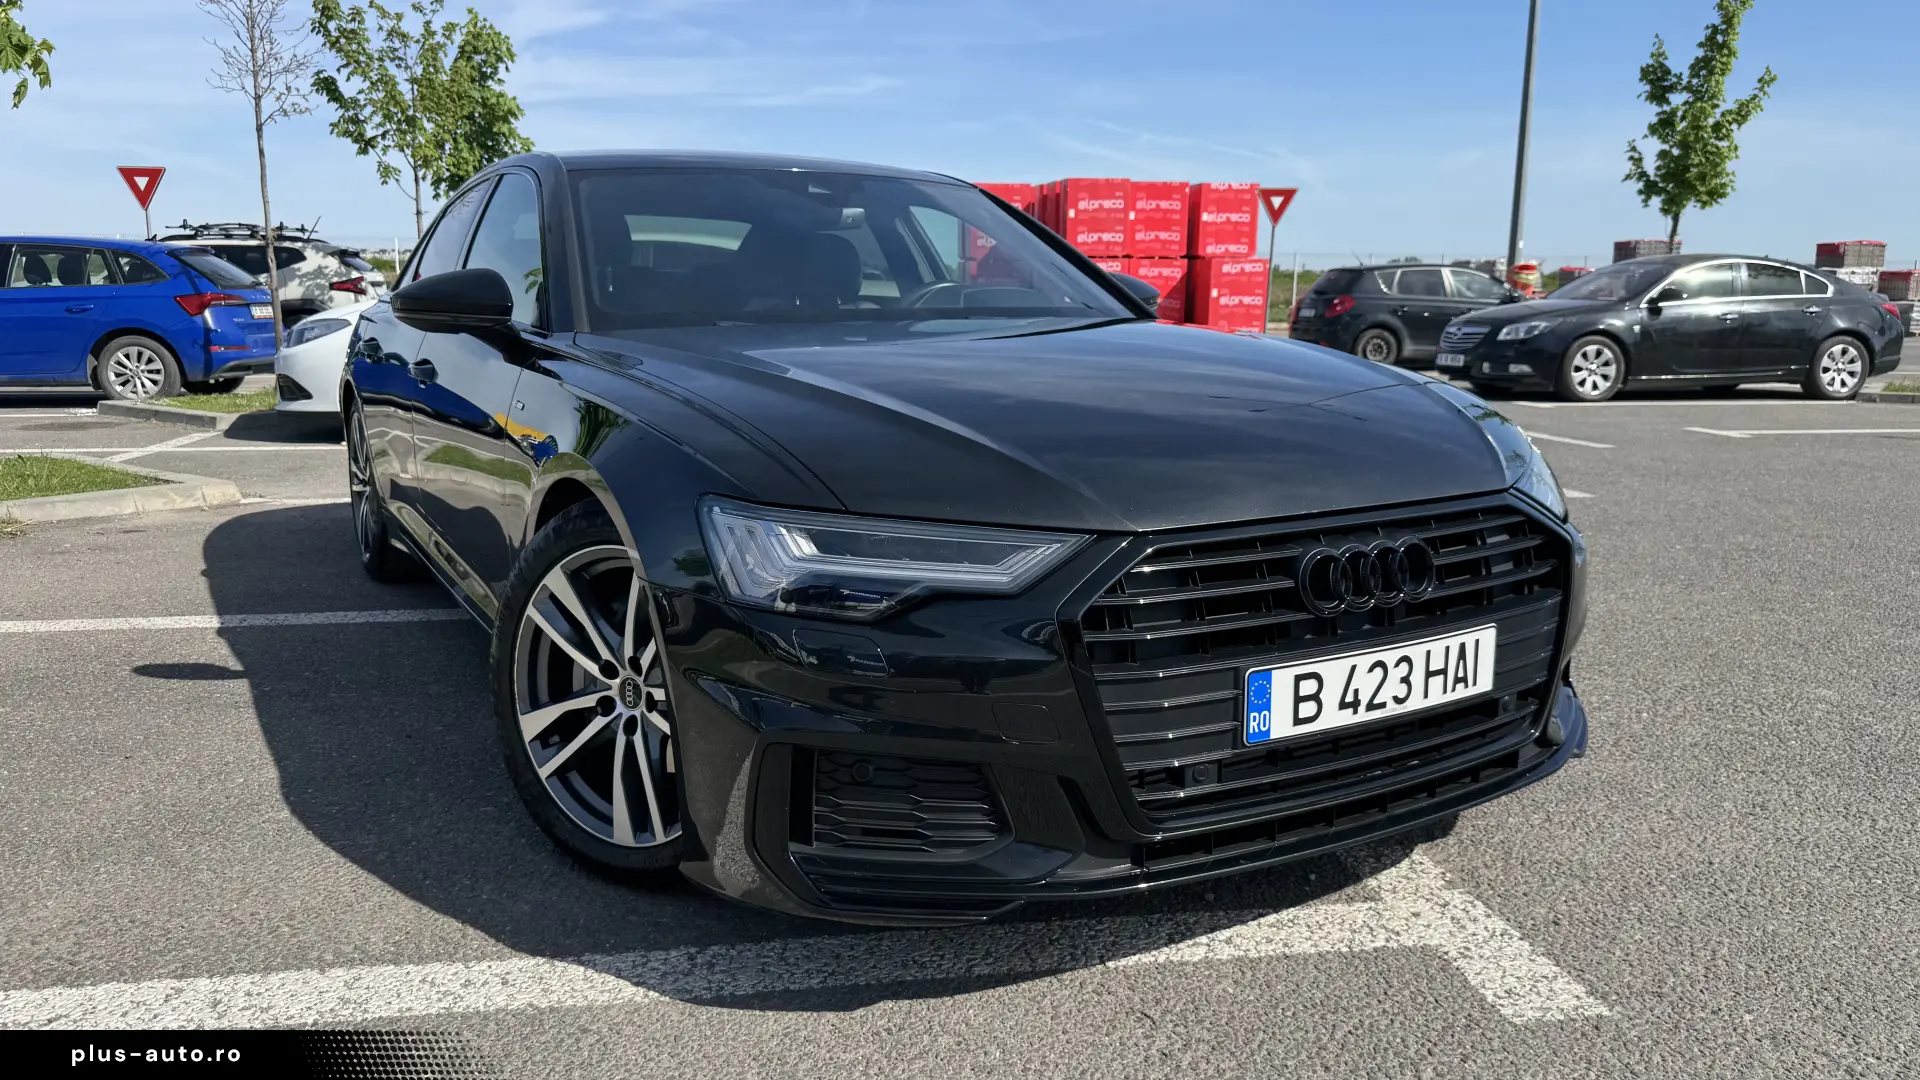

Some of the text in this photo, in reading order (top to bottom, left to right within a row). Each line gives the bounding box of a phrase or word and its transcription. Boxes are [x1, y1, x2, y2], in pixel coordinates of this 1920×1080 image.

[1078, 198, 1124, 211] elpreco
[1136, 198, 1181, 211] elpreco
[1207, 211, 1250, 224] elpreco
[1077, 231, 1124, 244] elpreco
[1135, 229, 1180, 242] elpreco
[1206, 243, 1248, 255] elpreco
[1138, 265, 1181, 277] elpreco
[1222, 262, 1263, 274] elpreco
[1219, 294, 1262, 306] elpreco
[1292, 638, 1480, 728] B 423 HAI
[1250, 710, 1270, 734] RO
